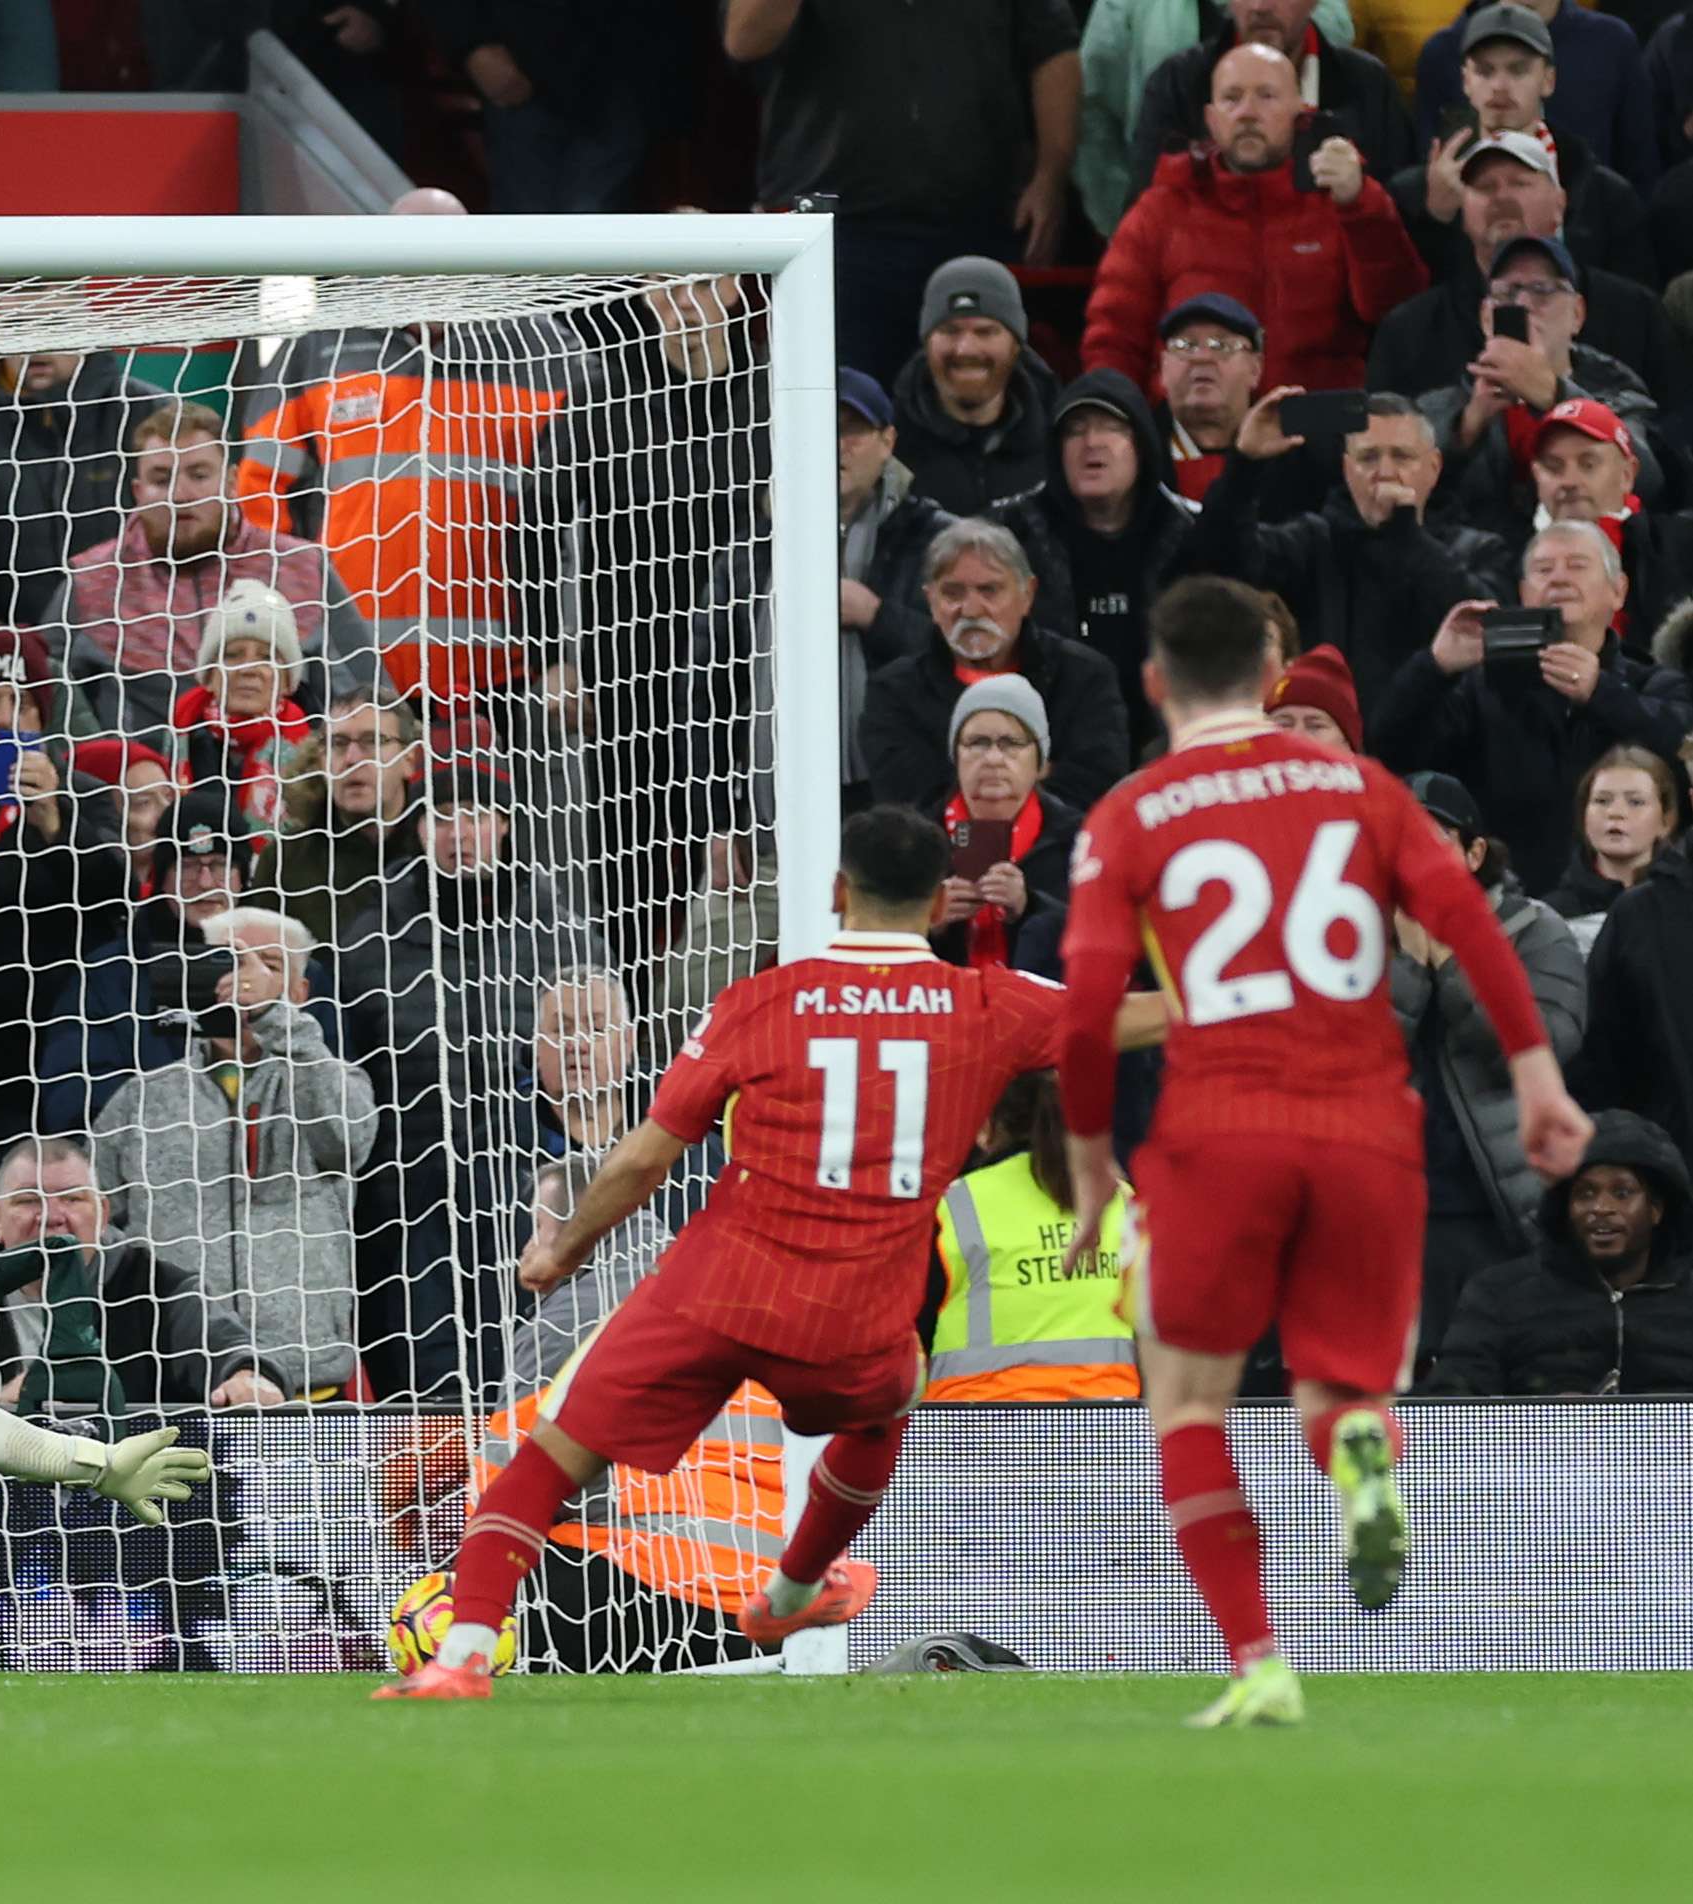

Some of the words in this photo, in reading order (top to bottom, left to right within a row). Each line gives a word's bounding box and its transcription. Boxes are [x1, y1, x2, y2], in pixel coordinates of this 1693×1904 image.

[1135, 758, 1365, 831] ROBERTSON
[1160, 819, 1387, 1027] 26
[808, 1037, 929, 1199] 11
[1038, 1222, 1101, 1251] HE
